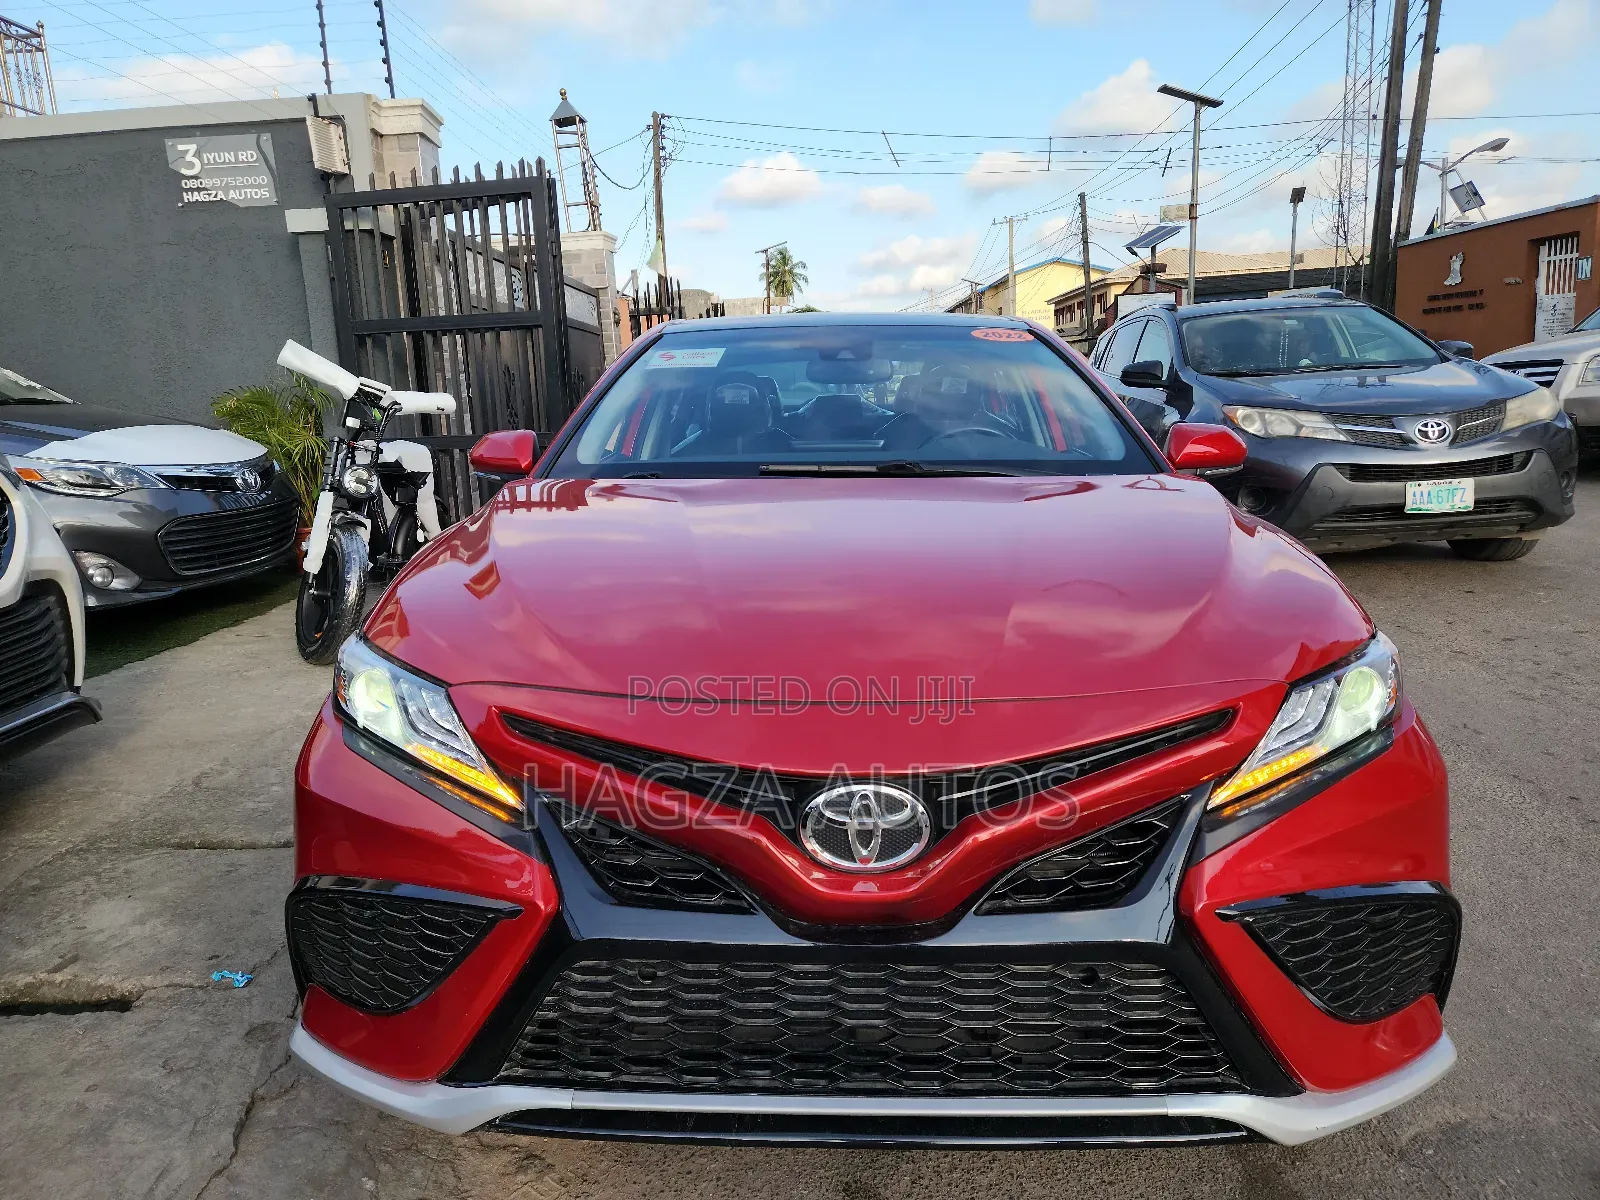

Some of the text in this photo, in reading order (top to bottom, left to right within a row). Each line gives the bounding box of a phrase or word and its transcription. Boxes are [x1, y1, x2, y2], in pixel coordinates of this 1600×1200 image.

[176, 143, 257, 176] 3 IYUN RD
[181, 176, 268, 189] 08099752000
[182, 188, 270, 203] HAGZA AUTOS
[1577, 257, 1592, 279] IN
[980, 331, 1027, 340] 2022
